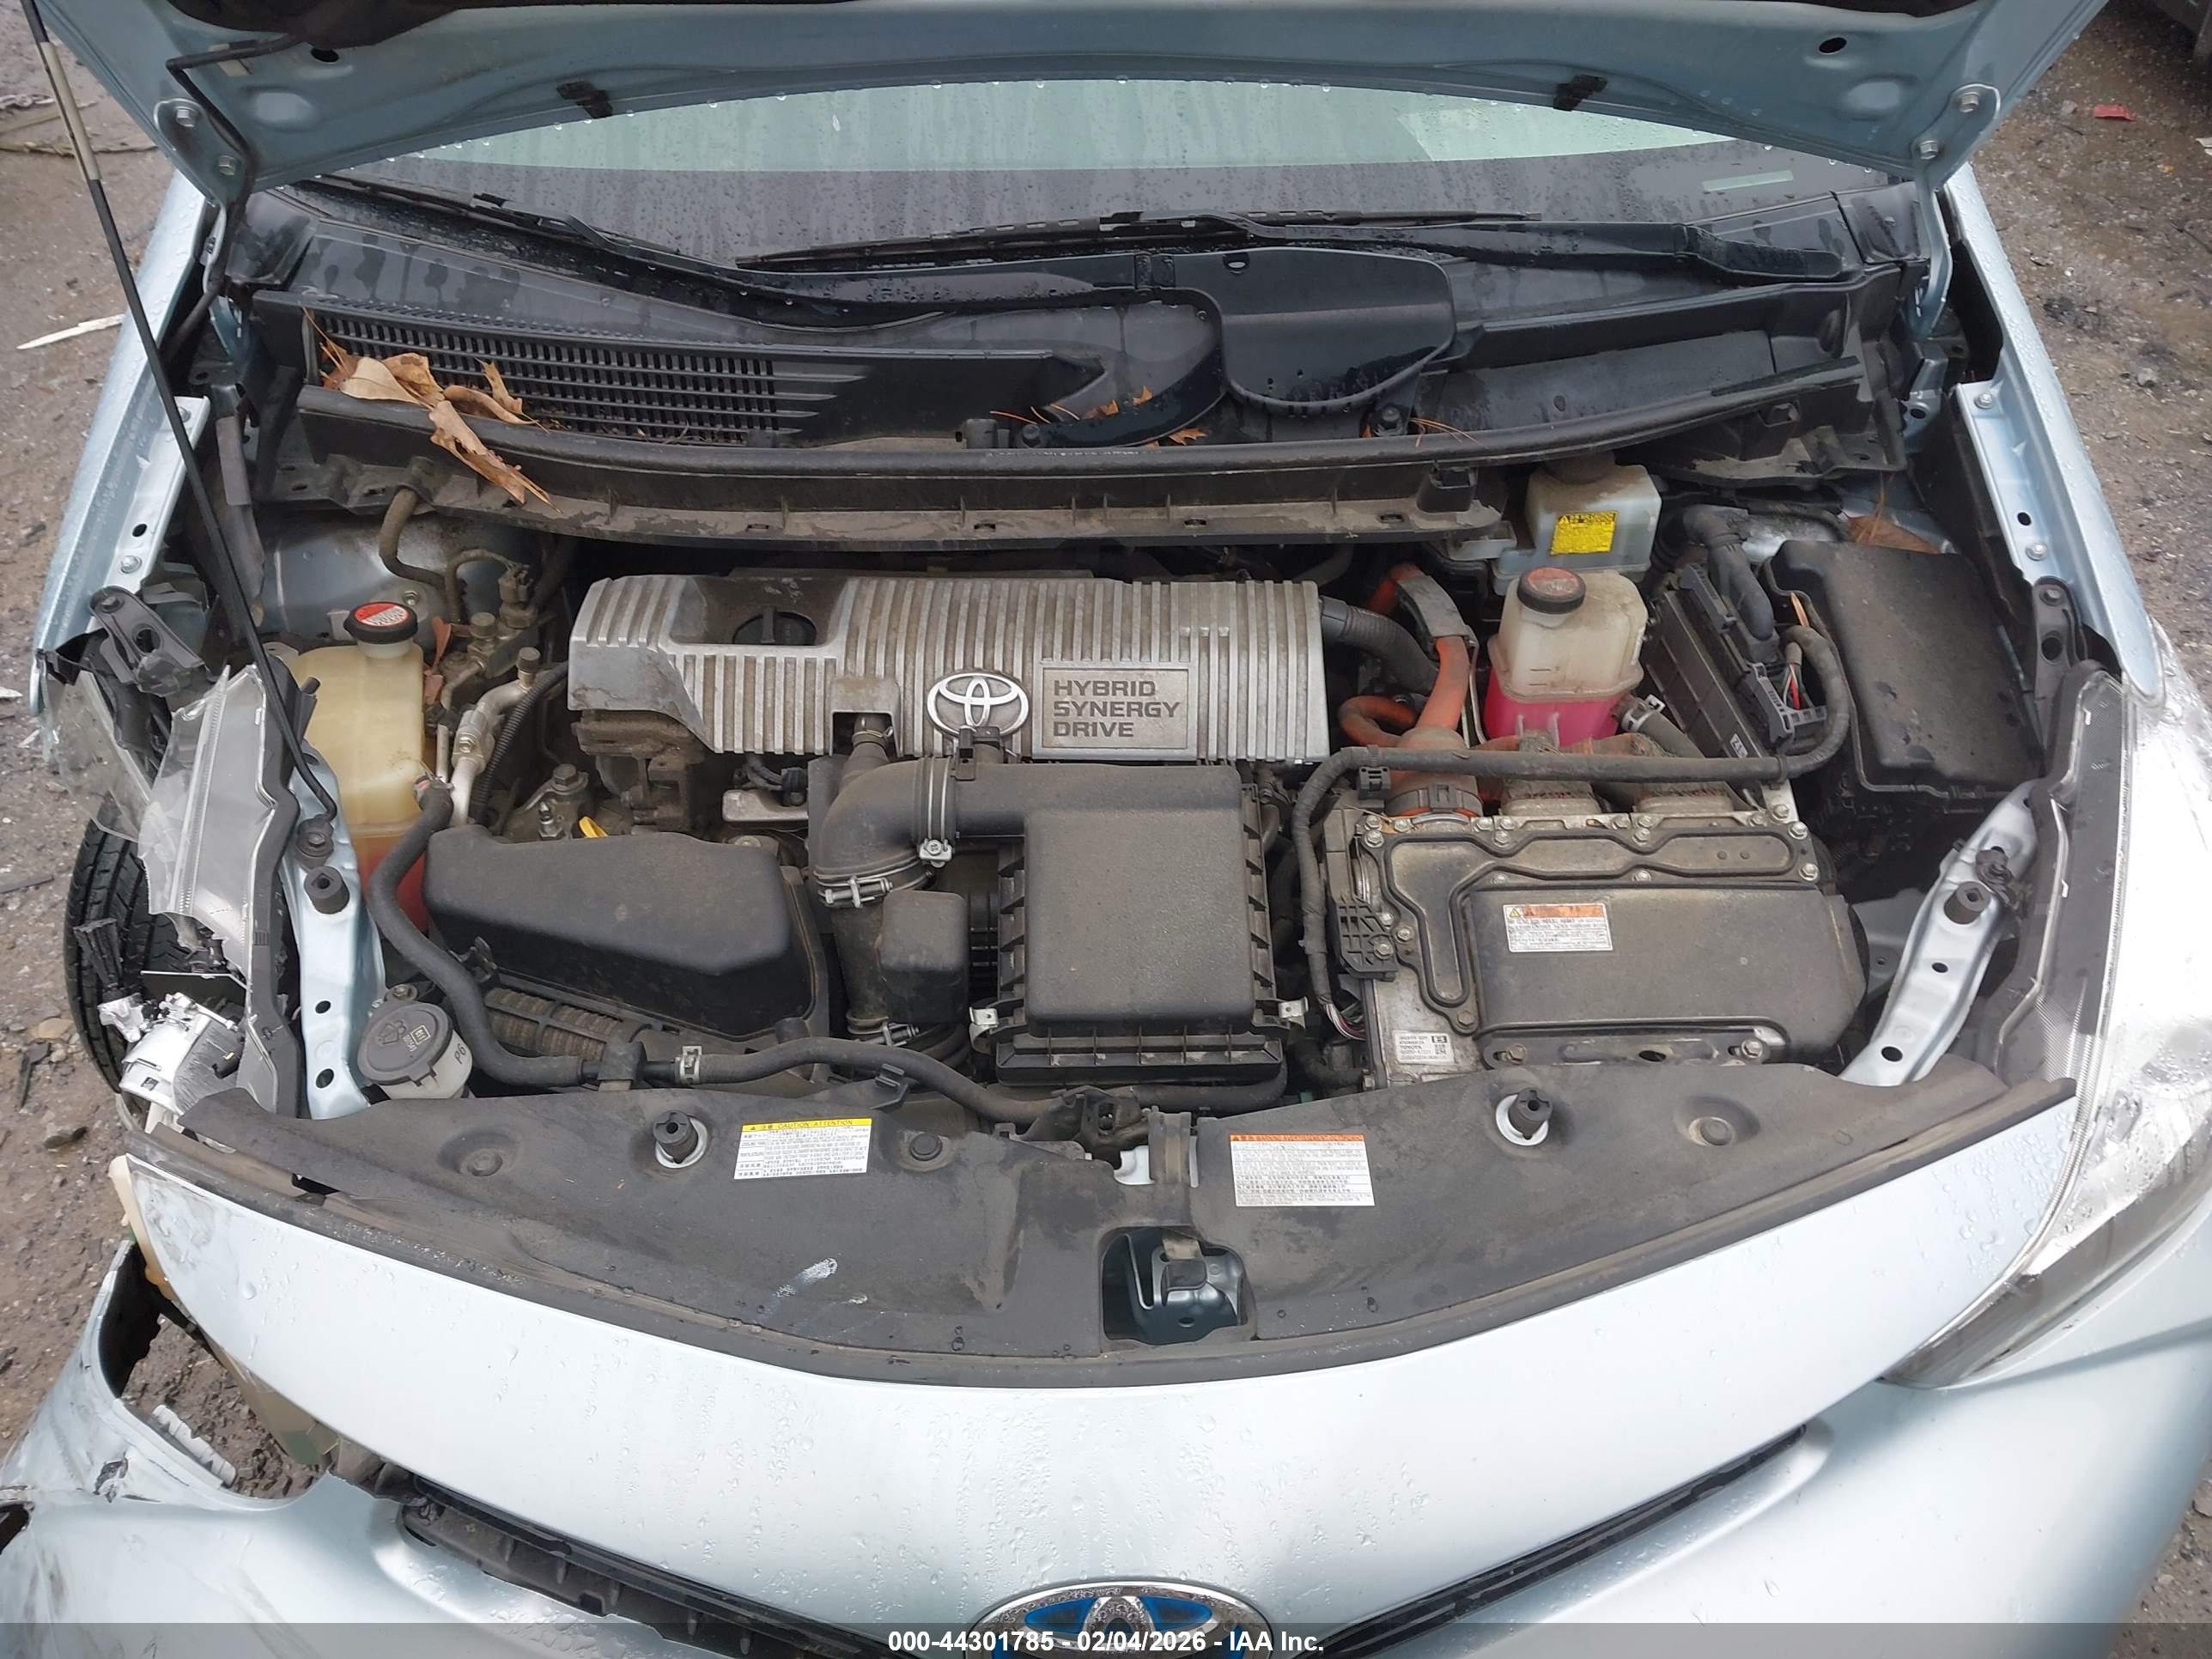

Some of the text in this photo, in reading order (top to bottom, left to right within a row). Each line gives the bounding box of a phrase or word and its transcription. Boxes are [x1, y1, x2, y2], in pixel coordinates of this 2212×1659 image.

[1054, 679, 1156, 697] HYBRID
[1053, 701, 1181, 718] SYNERGY
[1053, 721, 1134, 738] DRIVE
[453, 1043, 467, 1065] P6
